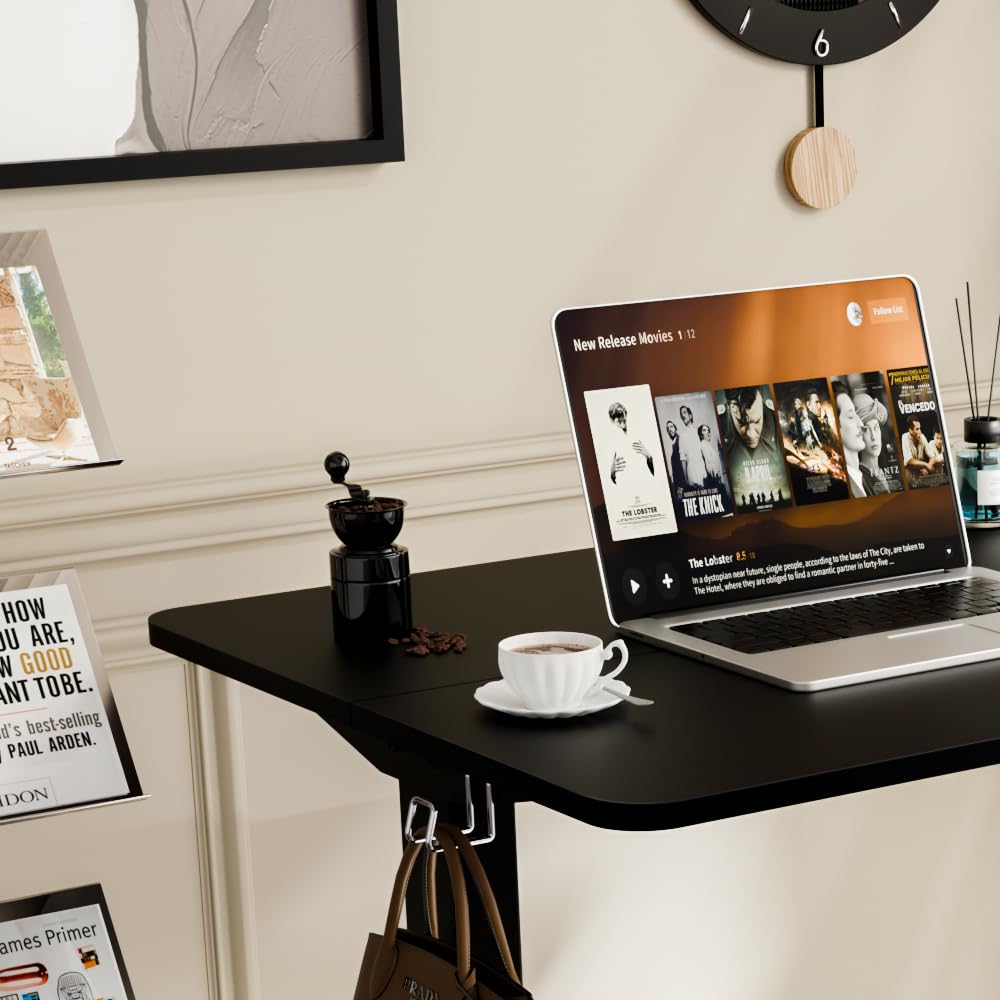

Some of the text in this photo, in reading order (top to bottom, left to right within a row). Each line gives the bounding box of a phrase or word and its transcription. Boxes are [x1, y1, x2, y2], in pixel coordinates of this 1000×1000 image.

[814, 28, 830, 58] 6
[873, 305, 904, 316] Follow List
[573, 339, 596, 352] New
[598, 334, 637, 349] Release
[638, 330, 673, 344] Movies
[4, 436, 16, 450] 2
[870, 466, 900, 476] FRANTZ
[622, 506, 658, 517] THE LOBSTER
[682, 494, 724, 518] THE KNICK
[688, 558, 704, 568] The
[704, 554, 733, 567] Lobster
[692, 576, 698, 584] In
[704, 572, 732, 584] dystopian
[732, 570, 746, 578] near
[746, 567, 766, 576] future,
[766, 564, 782, 574] single
[784, 560, 805, 571] people,
[805, 556, 833, 568] according
[839, 553, 849, 562] the
[848, 552, 862, 560] laws
[862, 549, 868, 558] of
[868, 548, 880, 557] The
[880, 547, 894, 556] City,
[893, 546, 902, 554] are
[902, 544, 918, 552] taken
[918, 542, 925, 550] to
[694, 586, 706, 595] The
[706, 583, 724, 593] Hotel,
[724, 582, 742, 590] where
[742, 579, 756, 588] they
[766, 574, 788, 584] obliged
[794, 570, 806, 579] find
[812, 566, 836, 576] romantic
[836, 564, 857, 574] partner
[858, 562, 864, 570] in
[863, 558, 888, 569] forty-five
[1, 597, 46, 624] HOW
[30, 621, 74, 646] ARE,
[20, 647, 73, 675] GOOD
[26, 712, 102, 734] best-selling
[8, 740, 44, 758] PAUL
[49, 732, 96, 752] ARDEN.
[45, 924, 96, 946] Primer
